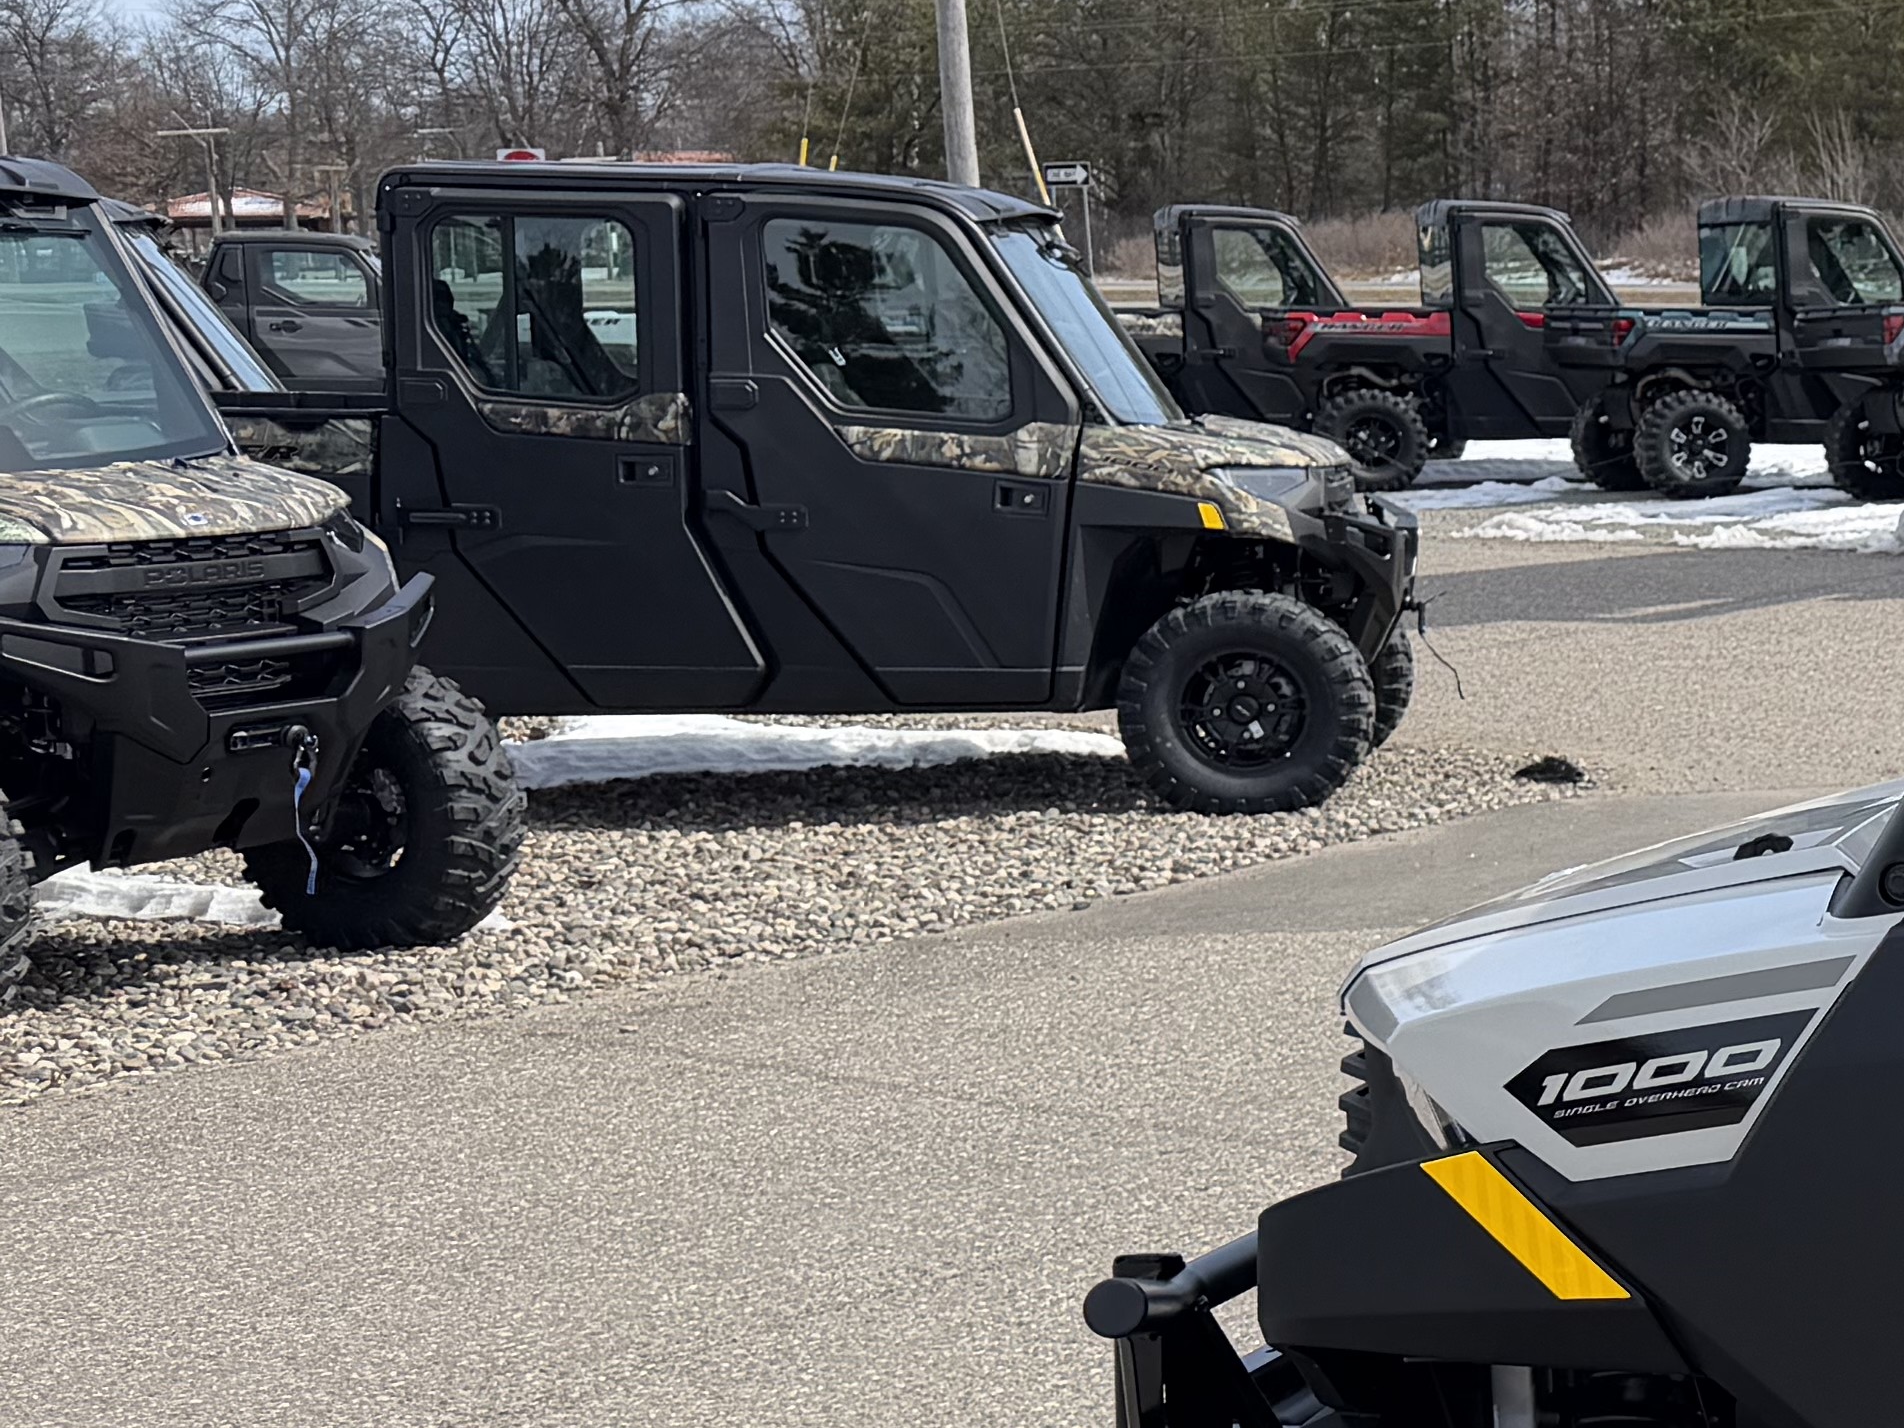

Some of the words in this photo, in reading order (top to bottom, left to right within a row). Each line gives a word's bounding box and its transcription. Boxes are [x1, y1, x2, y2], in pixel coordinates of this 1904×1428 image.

[144, 560, 265, 589] POLARIS
[1536, 1037, 1782, 1107] 1000
[1553, 1100, 1621, 1119] SINGLE
[1624, 1084, 1721, 1108] OVERHEAD
[1723, 1076, 1765, 1091] CAM
